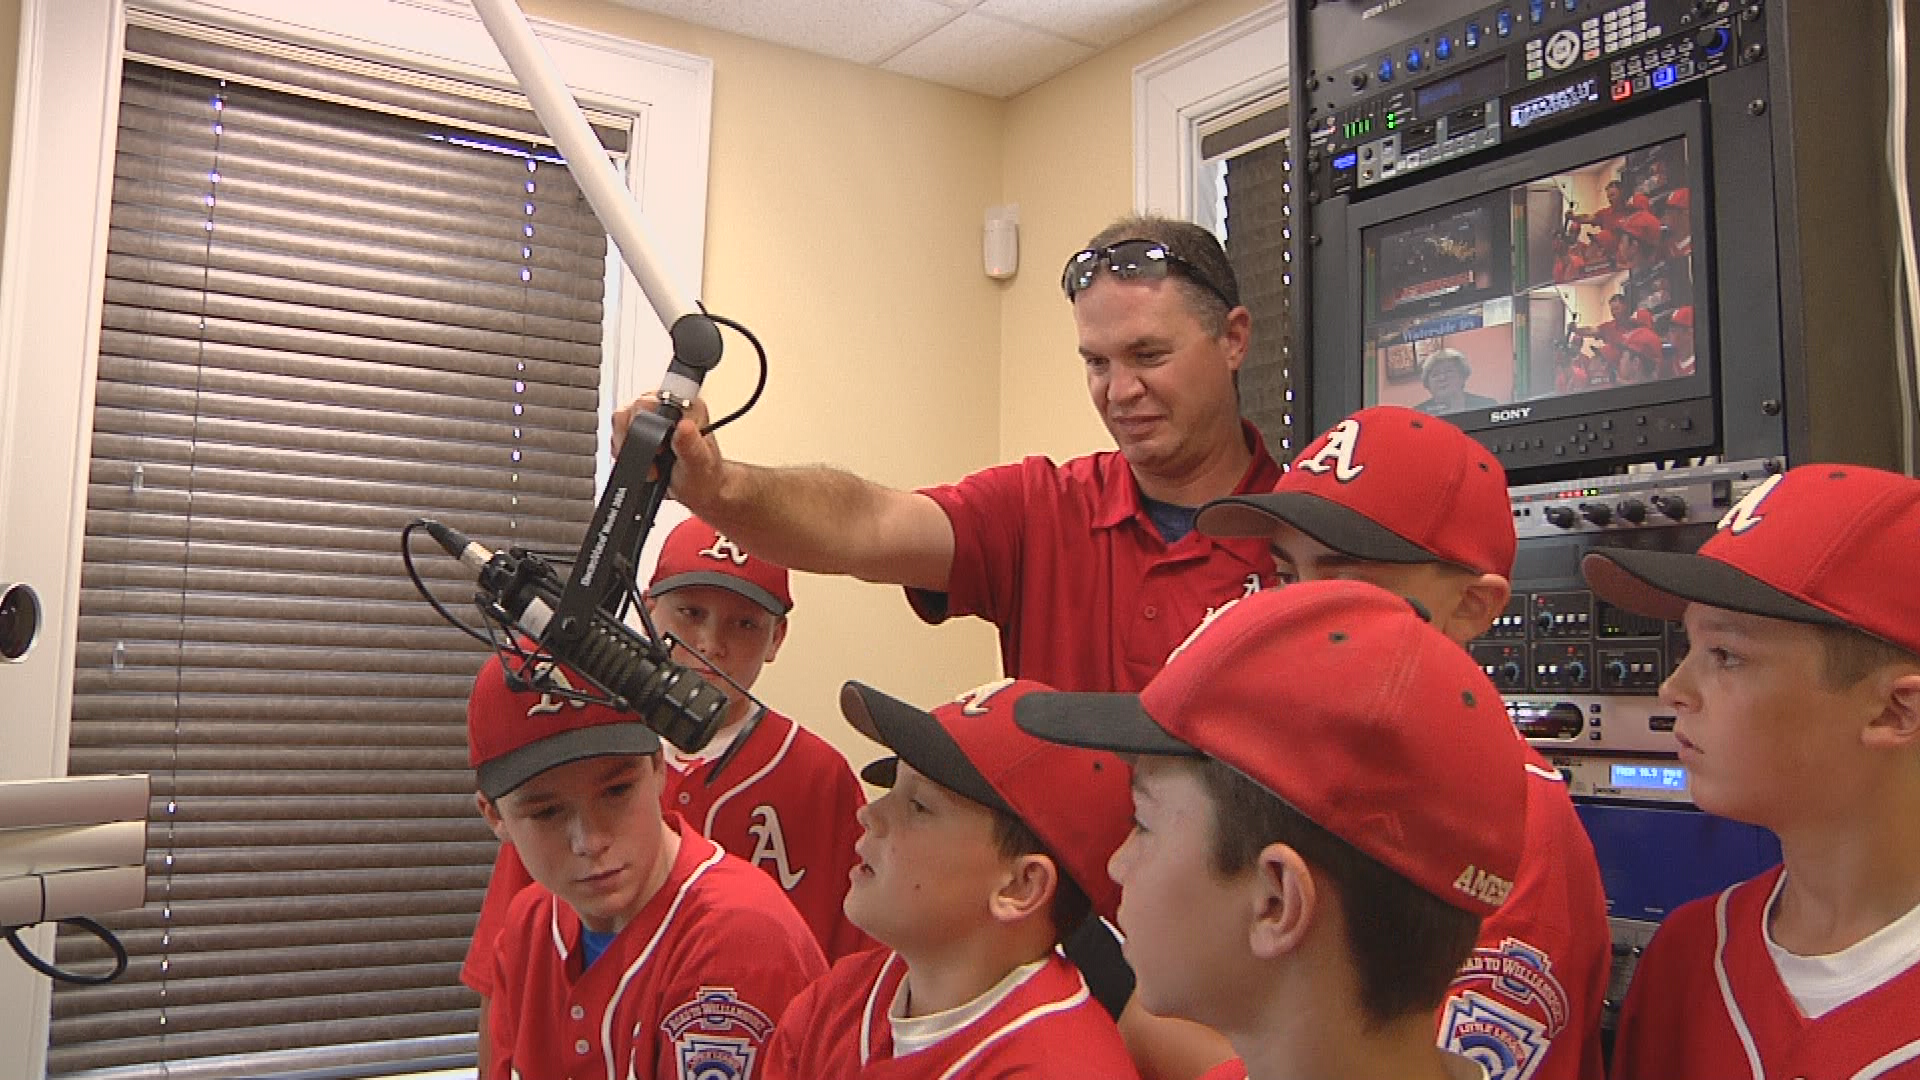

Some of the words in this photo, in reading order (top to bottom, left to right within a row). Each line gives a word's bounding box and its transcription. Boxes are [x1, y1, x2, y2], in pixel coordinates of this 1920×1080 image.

[1490, 407, 1532, 423] SONY
[1298, 418, 1364, 482] A
[747, 805, 807, 891] A
[1483, 957, 1501, 972] TO
